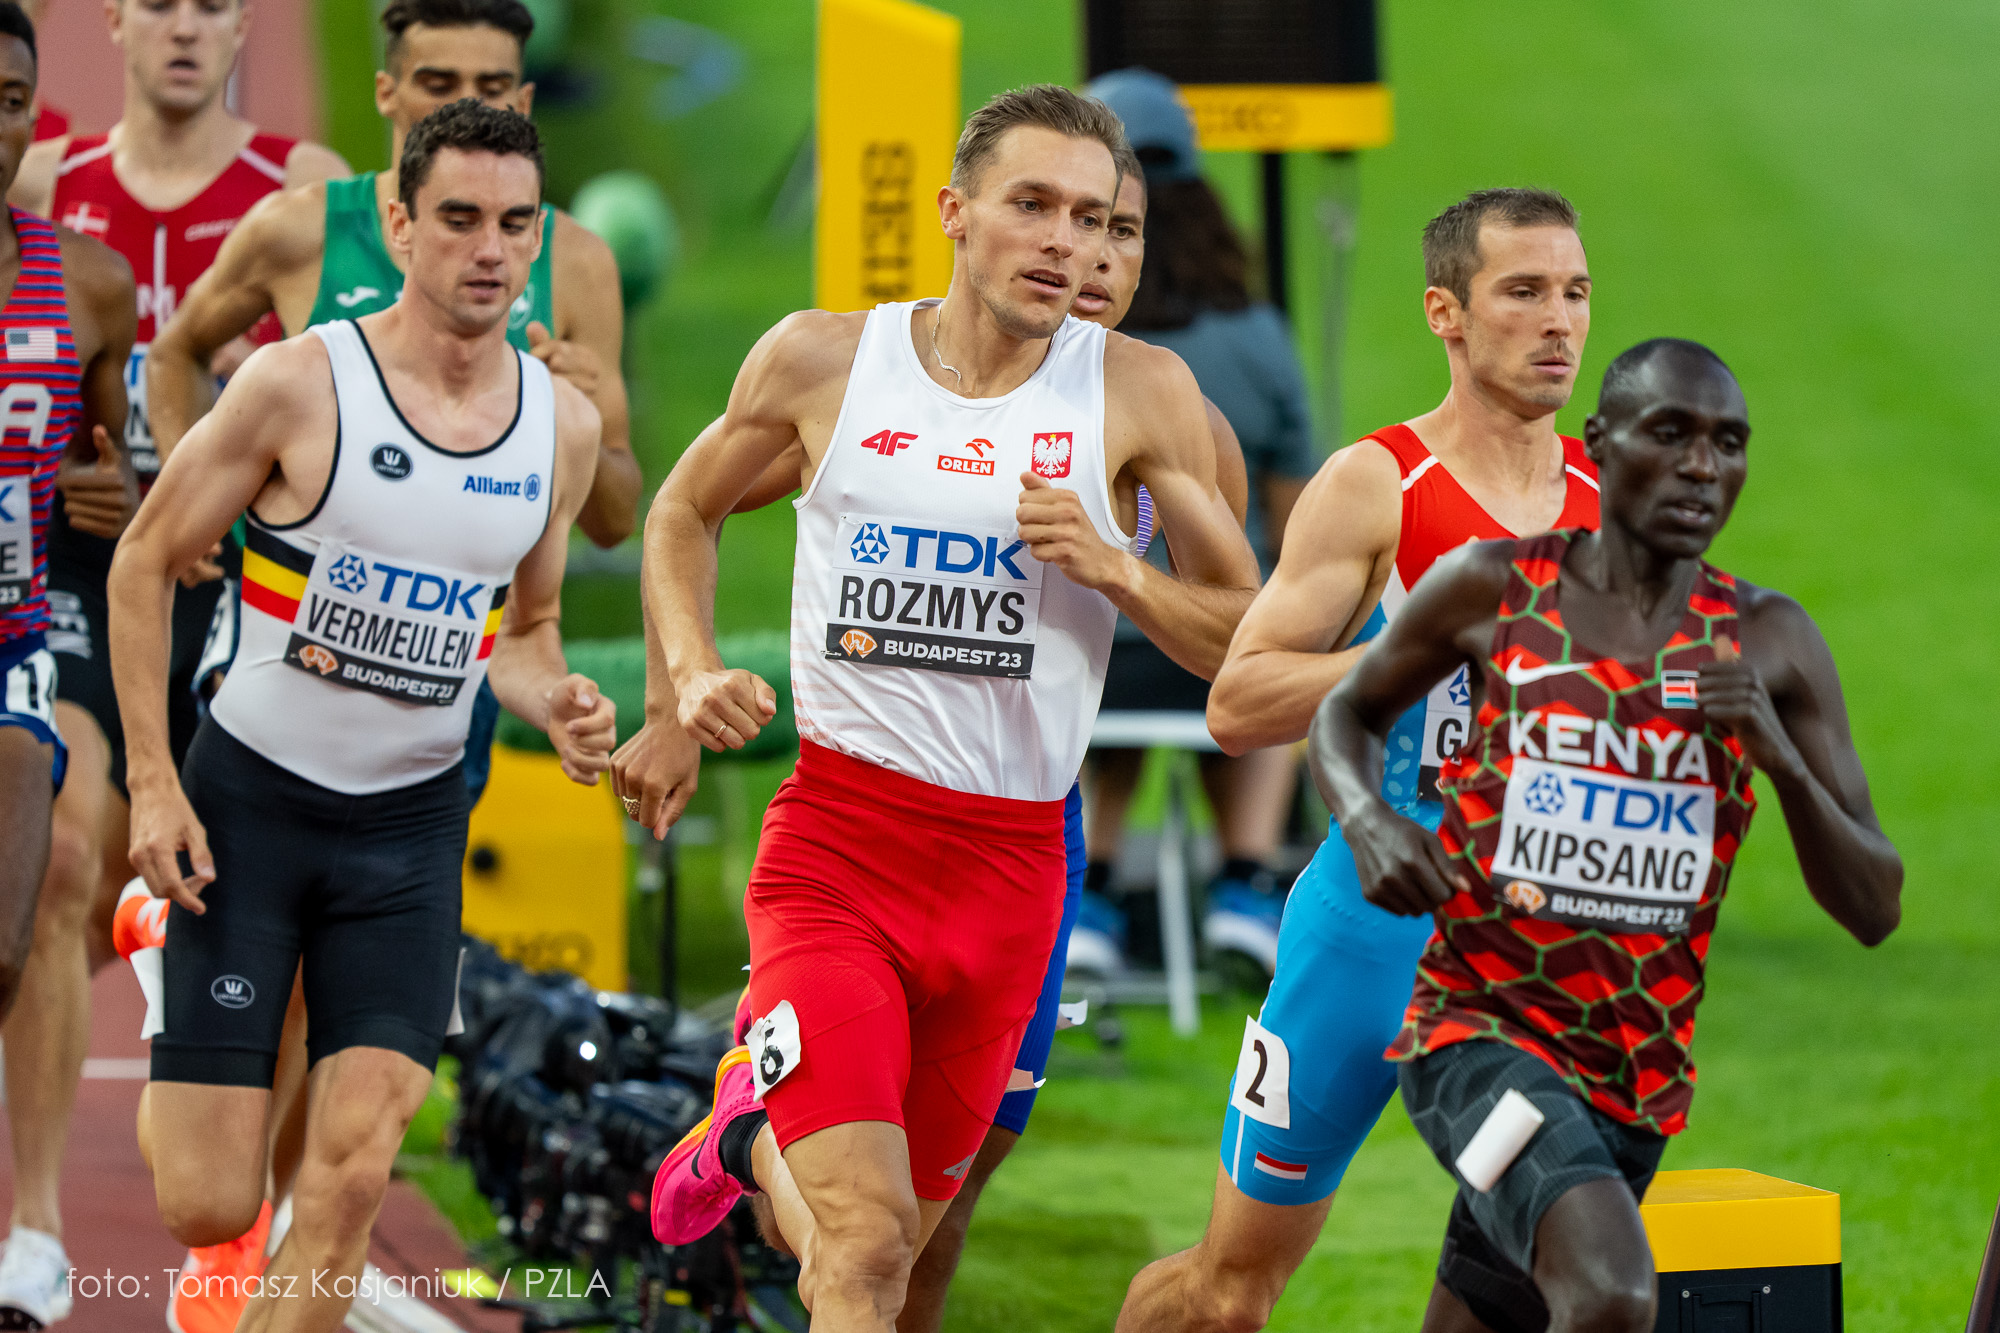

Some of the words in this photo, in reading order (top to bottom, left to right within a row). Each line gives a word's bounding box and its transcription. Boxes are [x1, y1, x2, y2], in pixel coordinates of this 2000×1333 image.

[861, 429, 919, 457] 4F
[940, 456, 992, 476] ORLEN
[463, 475, 521, 496] Allianz
[891, 525, 1029, 581] TDK
[372, 562, 486, 621] TDK
[838, 575, 1025, 636] ROZMYS
[306, 593, 477, 671] VERMEULEN
[884, 640, 998, 667] BUDAPEST
[998, 651, 1023, 669] 23
[342, 662, 439, 699] BUDAPEST
[1508, 710, 1711, 784] KENYA
[1571, 779, 1700, 837] TDK
[1511, 824, 1697, 895] KIPSANG
[1551, 894, 1664, 926] BUDAPEST
[1245, 1039, 1268, 1108] 2
